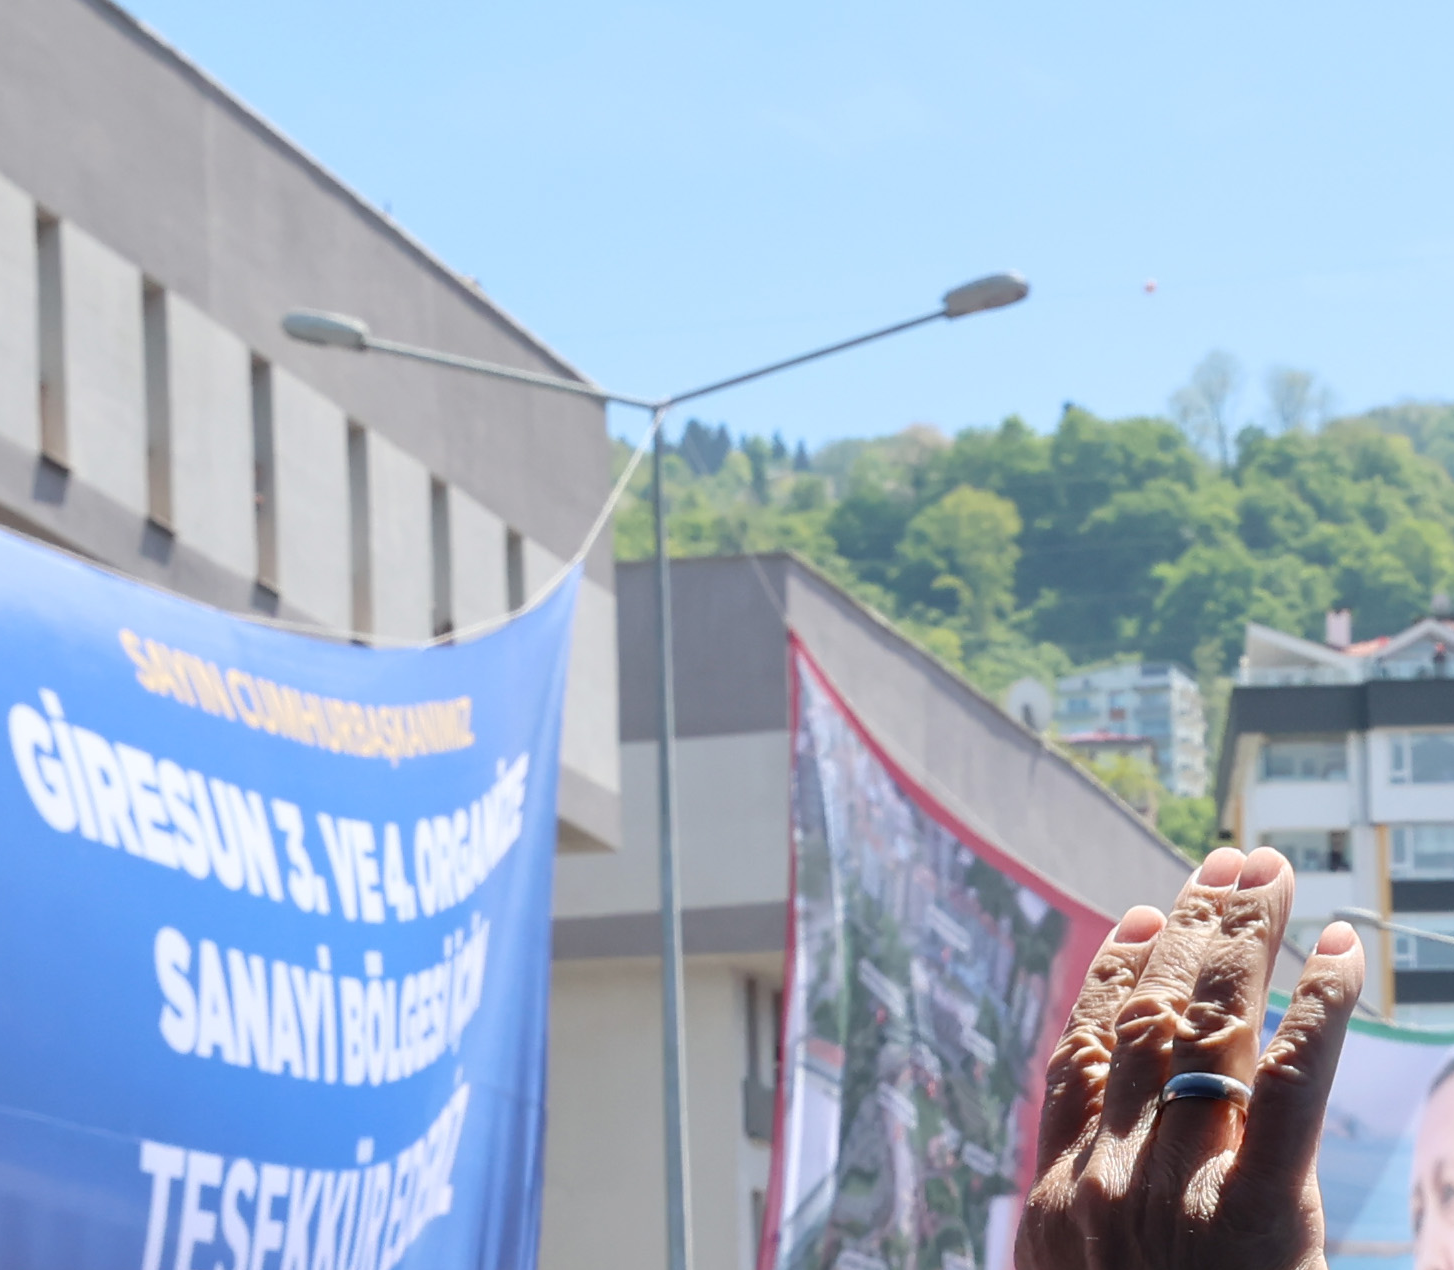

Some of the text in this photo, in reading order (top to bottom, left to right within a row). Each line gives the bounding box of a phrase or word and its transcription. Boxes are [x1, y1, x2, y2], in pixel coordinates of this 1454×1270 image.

[8, 687, 281, 898] GİRESUN
[279, 803, 327, 915] 3.
[319, 812, 383, 922] VE
[155, 925, 338, 1084] SANAYİ
[344, 935, 453, 1088] BÖLGESİ
